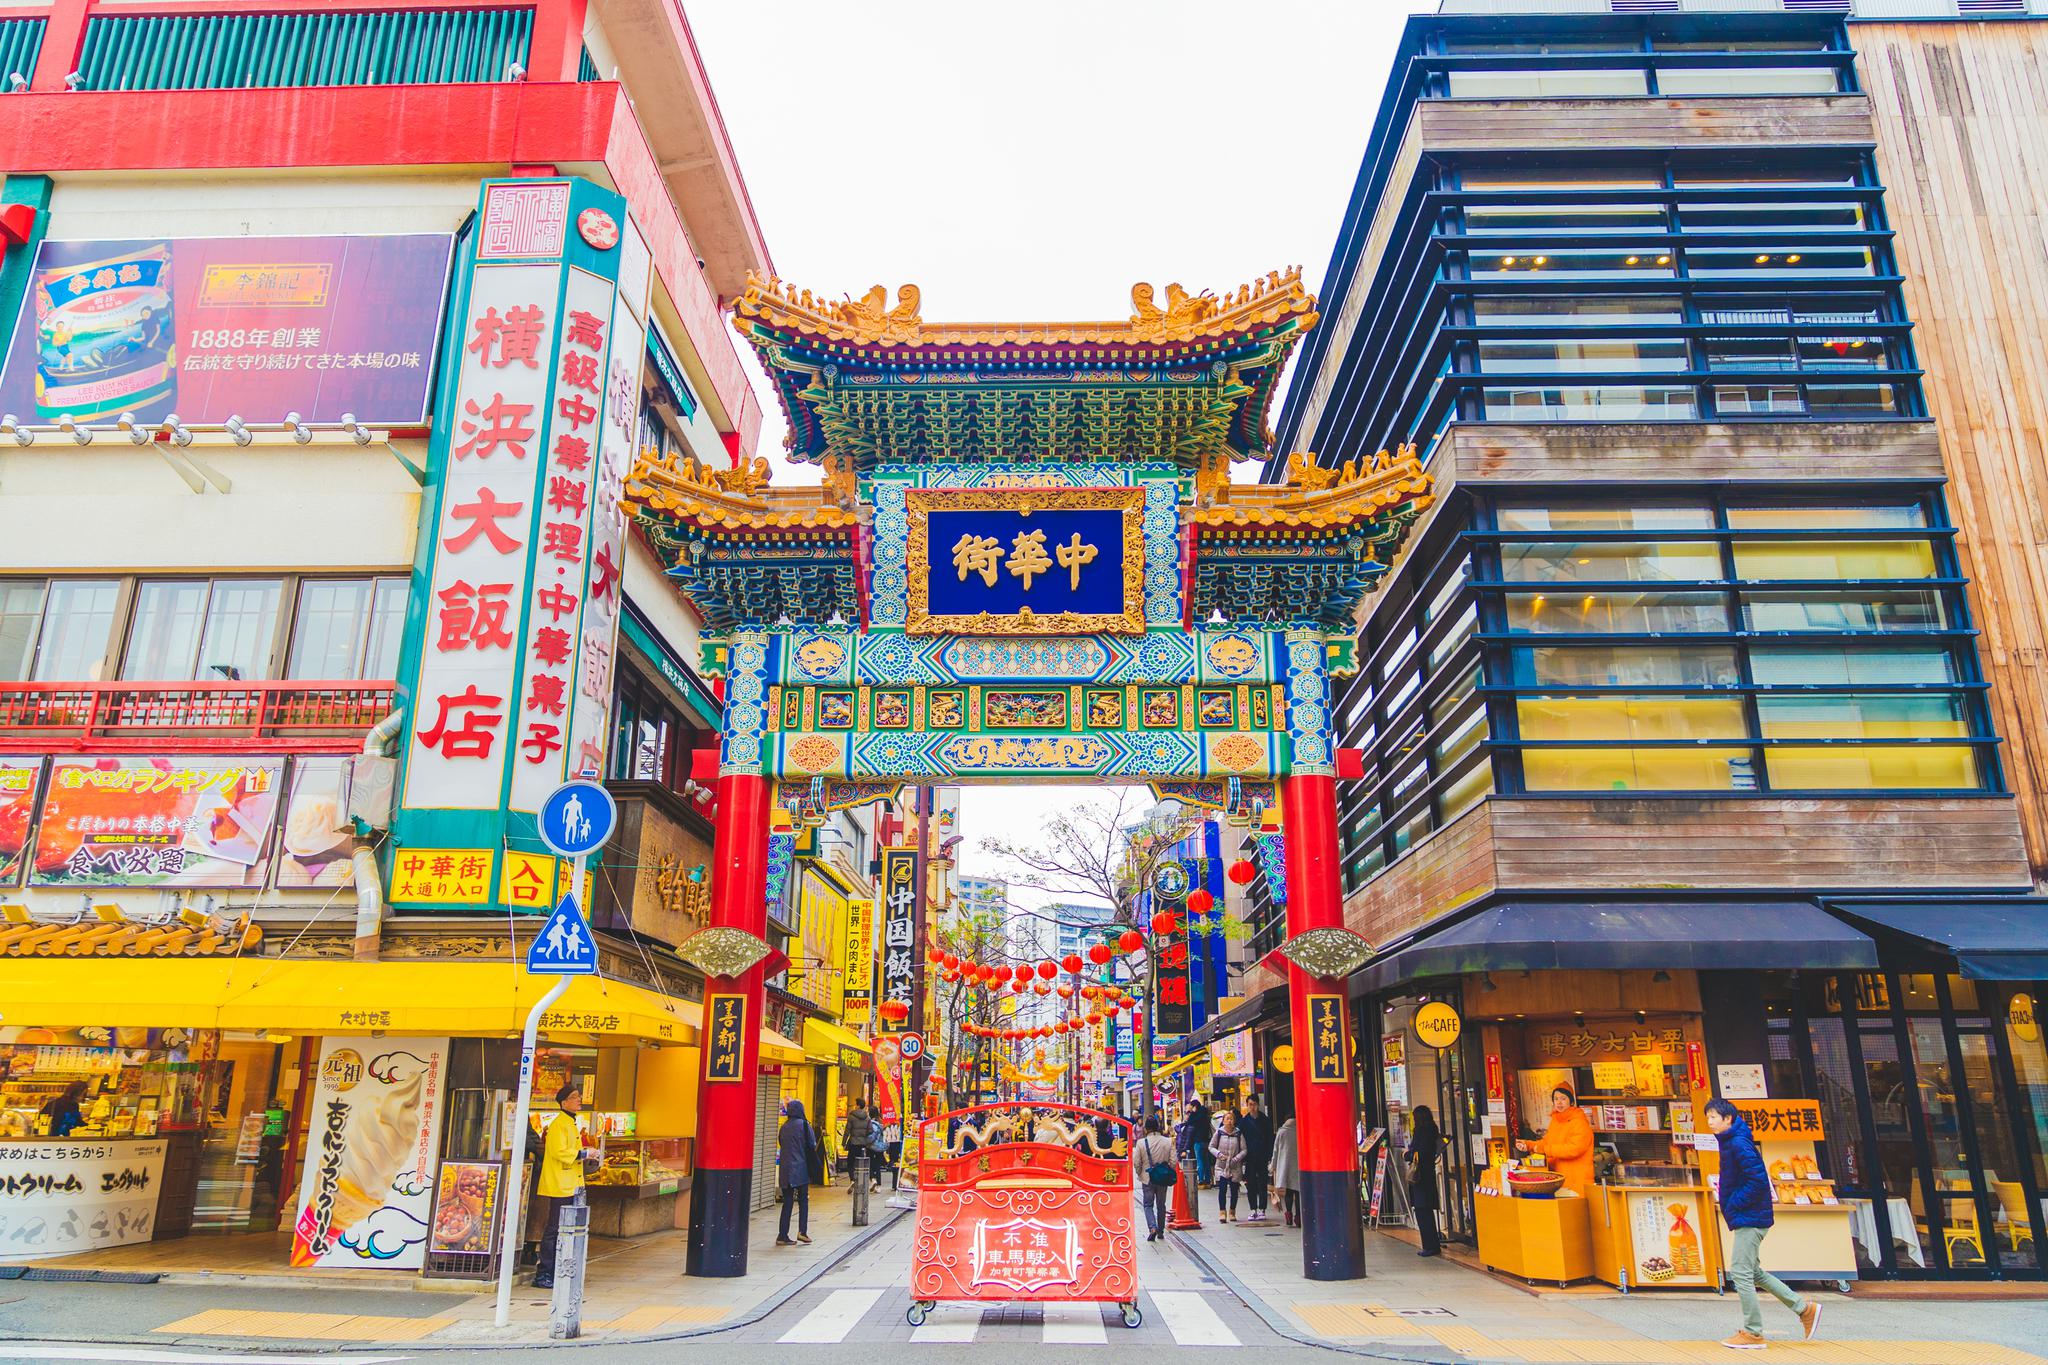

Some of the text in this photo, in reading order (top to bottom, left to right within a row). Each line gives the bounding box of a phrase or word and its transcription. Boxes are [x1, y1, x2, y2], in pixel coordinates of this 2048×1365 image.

[190, 327, 321, 348] 1888年創業
[184, 352, 420, 371] 伝統を守り続けてきた本場の味
[417, 304, 544, 760] 横浜大飯店
[68, 846, 185, 875] 食べ放題
[403, 856, 487, 879] 中華街
[400, 882, 483, 897] 大通り入口
[511, 860, 544, 900] 入口
[848, 905, 860, 985] 世界一の肉まん
[859, 902, 872, 988] 中国料理世界チャンピオン
[846, 999, 869, 1010] 100円
[340, 1011, 391, 1026] 大粒甘栗
[1418, 1018, 1458, 1032] The CAFE
[903, 1040, 919, 1053] 30
[1540, 1028, 1685, 1057] 聘珍大甘栗
[324, 1052, 361, 1083] 元祖
[426, 1052, 439, 1098] 中華街名物
[1739, 1108, 1820, 1132] 聘珍大甘栗
[416, 1101, 433, 1184] 横浜大飯店の自信作
[101, 1167, 149, 1191] エッグタルト
[312, 1098, 351, 1254] 杏仁ソフトクリーム
[1002, 1232, 1049, 1247] 不准
[986, 1250, 1065, 1265] 車馬駛入
[989, 1267, 1061, 1277] 加賀町警察署
